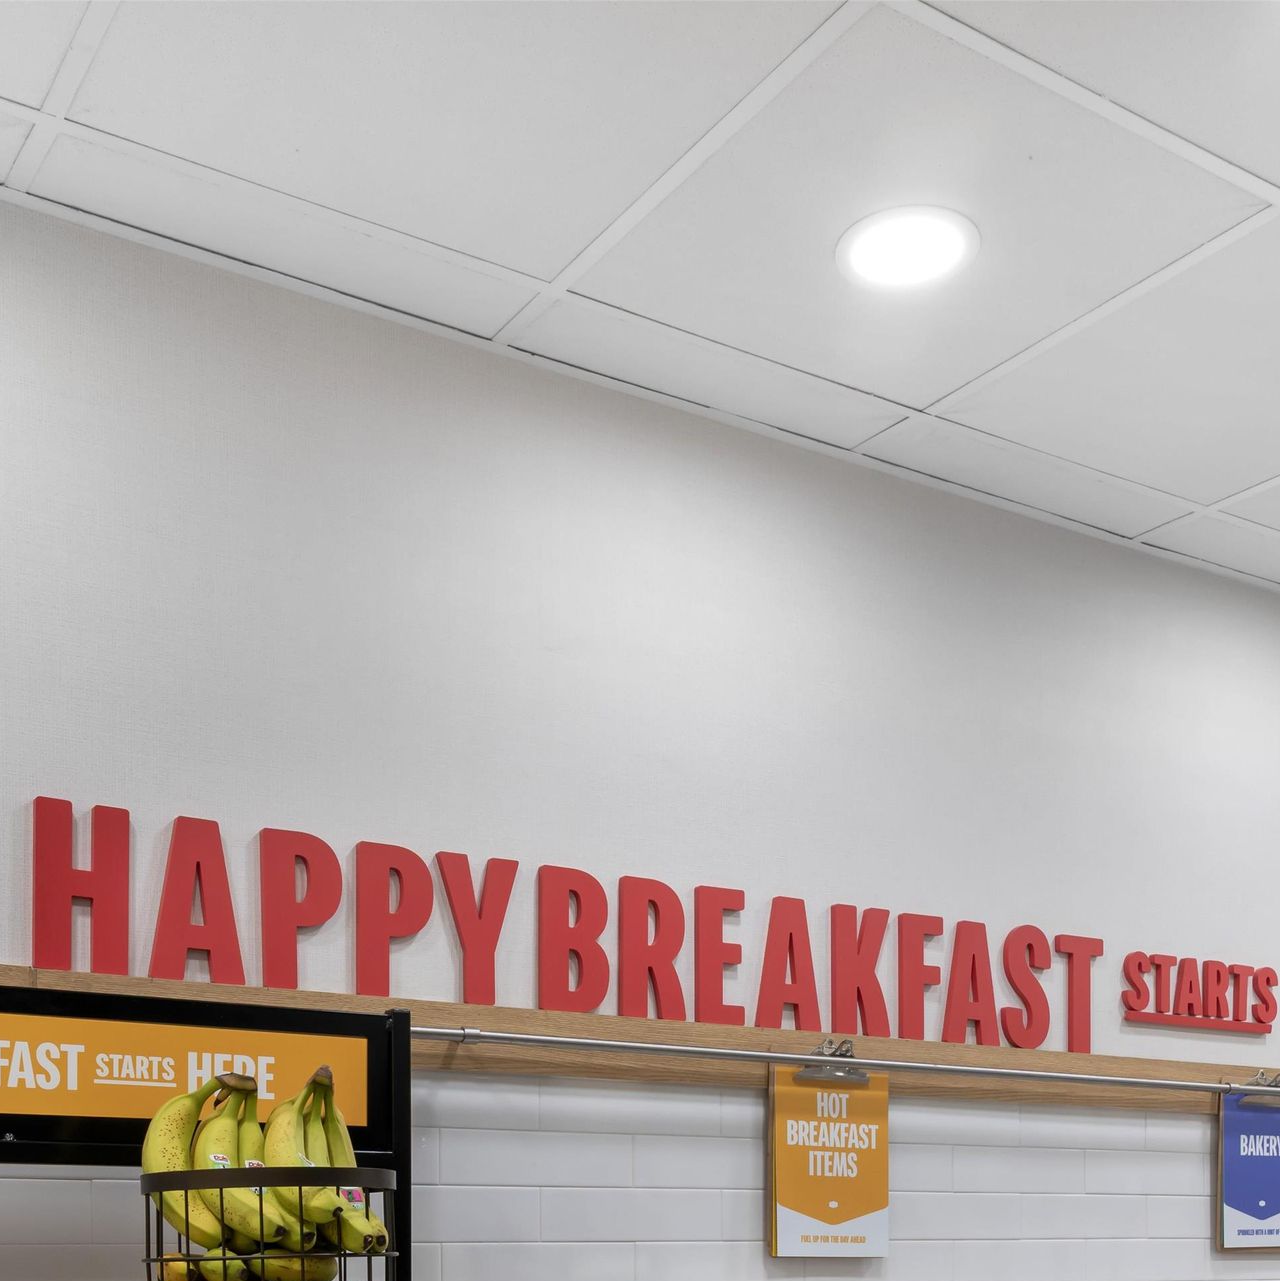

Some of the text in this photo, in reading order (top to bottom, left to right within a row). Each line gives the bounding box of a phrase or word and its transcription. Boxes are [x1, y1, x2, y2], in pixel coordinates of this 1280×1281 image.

[31, 796, 519, 1006] HAPPY
[538, 865, 1104, 1054] BREAKFAST
[1121, 951, 1278, 1025] STARTS
[95, 1053, 176, 1082] STARTS
[816, 1091, 849, 1119] HOT
[786, 1119, 879, 1150] BREAKFAST
[808, 1150, 858, 1178] ITEMS
